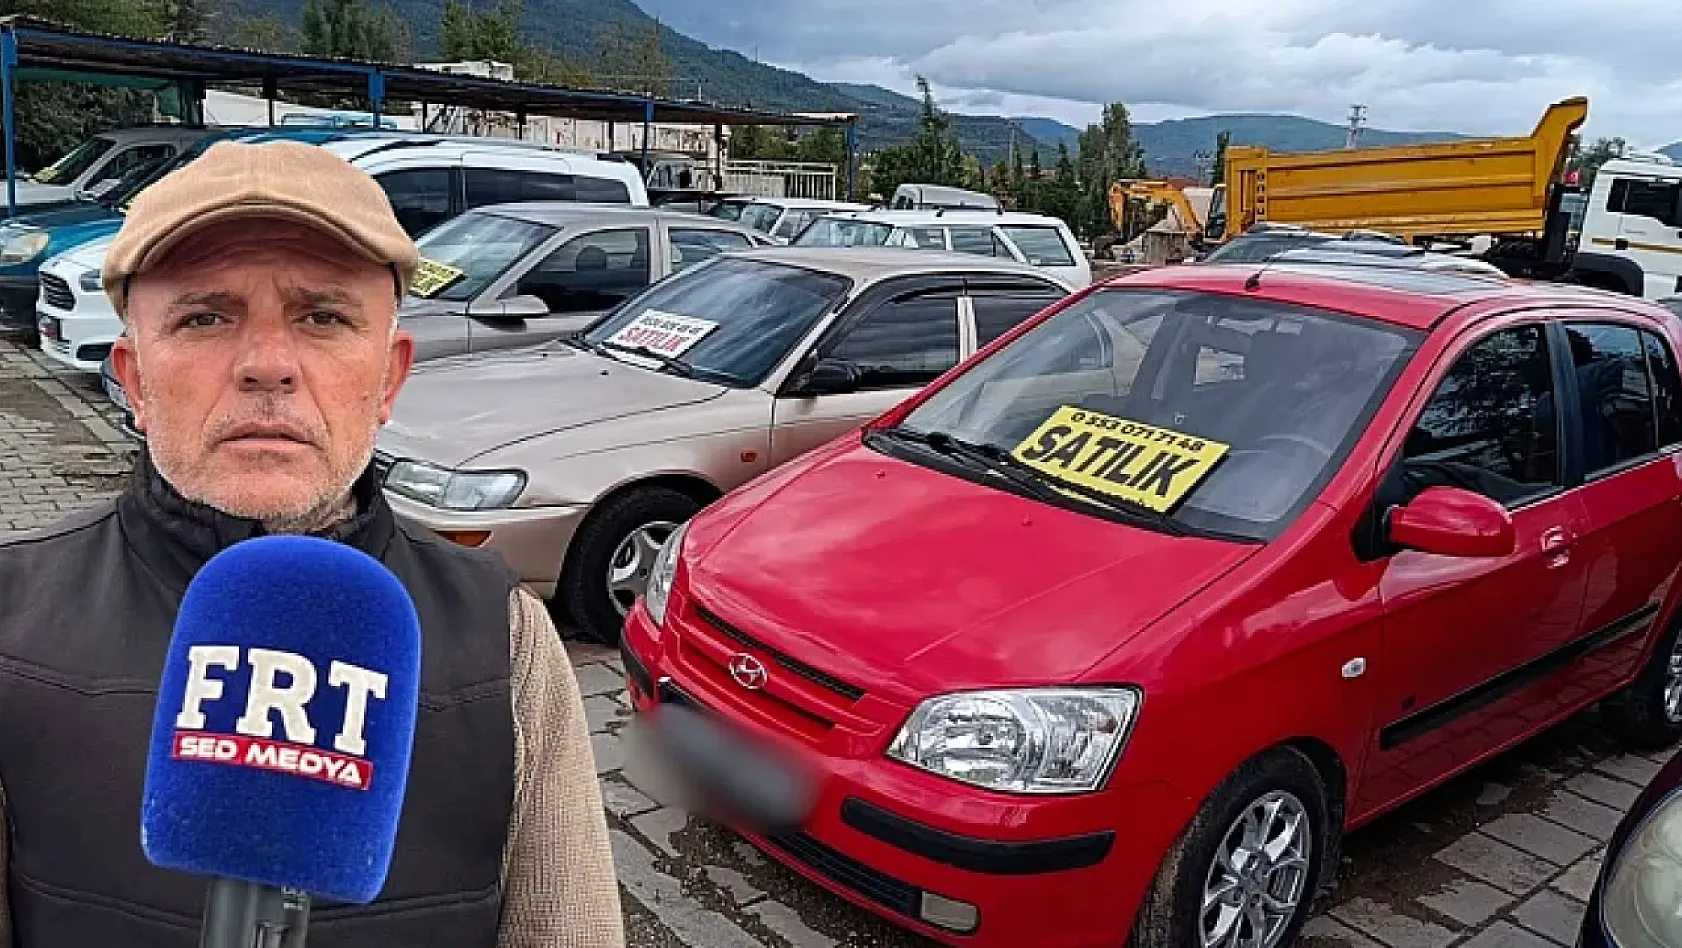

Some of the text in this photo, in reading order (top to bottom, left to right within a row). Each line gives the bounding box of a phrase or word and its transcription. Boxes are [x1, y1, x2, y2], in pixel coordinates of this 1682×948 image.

[1021, 425, 1200, 497] SATILIK
[176, 646, 388, 755] FRT
[179, 736, 362, 784] SED MEDYA
